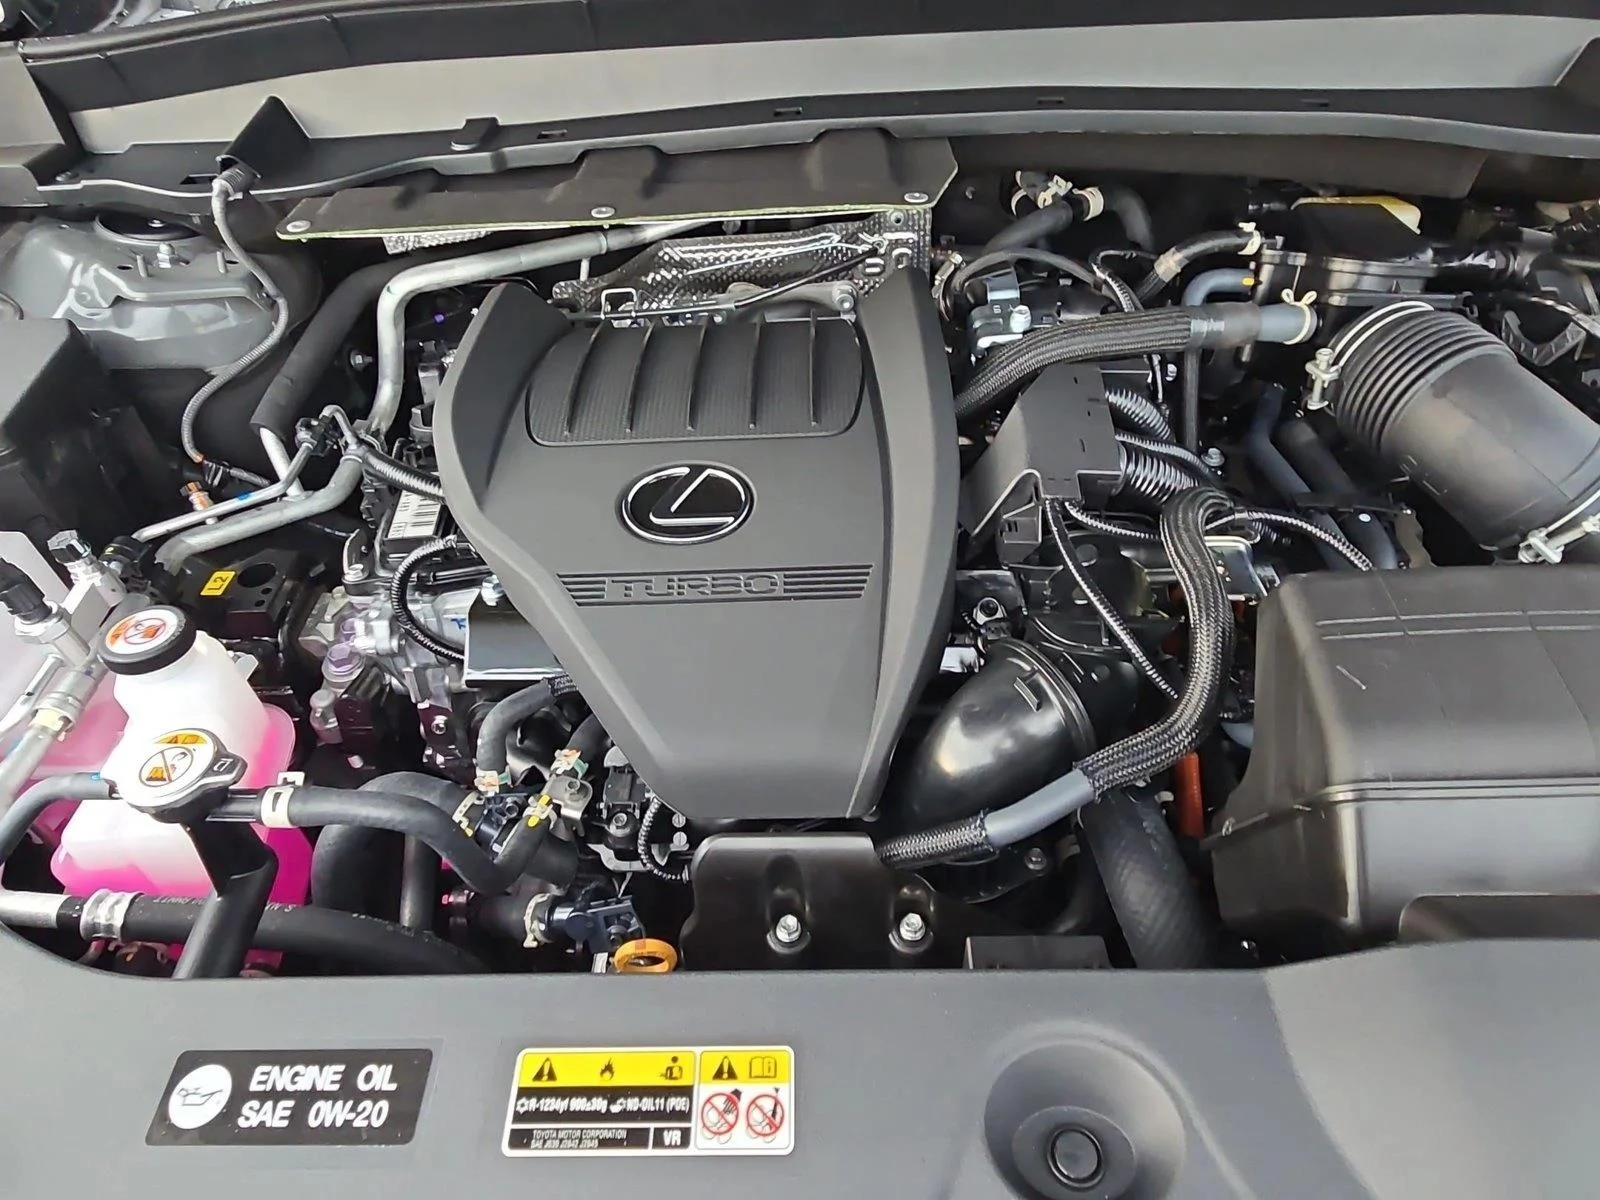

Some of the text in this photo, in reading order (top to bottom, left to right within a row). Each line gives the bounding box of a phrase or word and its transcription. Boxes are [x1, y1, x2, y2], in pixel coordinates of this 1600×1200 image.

[207, 576, 230, 591] L2
[610, 573, 781, 598] TURBO
[248, 1064, 398, 1092] ENGINE OIL
[237, 1099, 389, 1128] SAE 0W-20
[533, 1128, 627, 1139] TOYOTA MOTOR CORPORATION
[663, 1129, 682, 1146] VR
